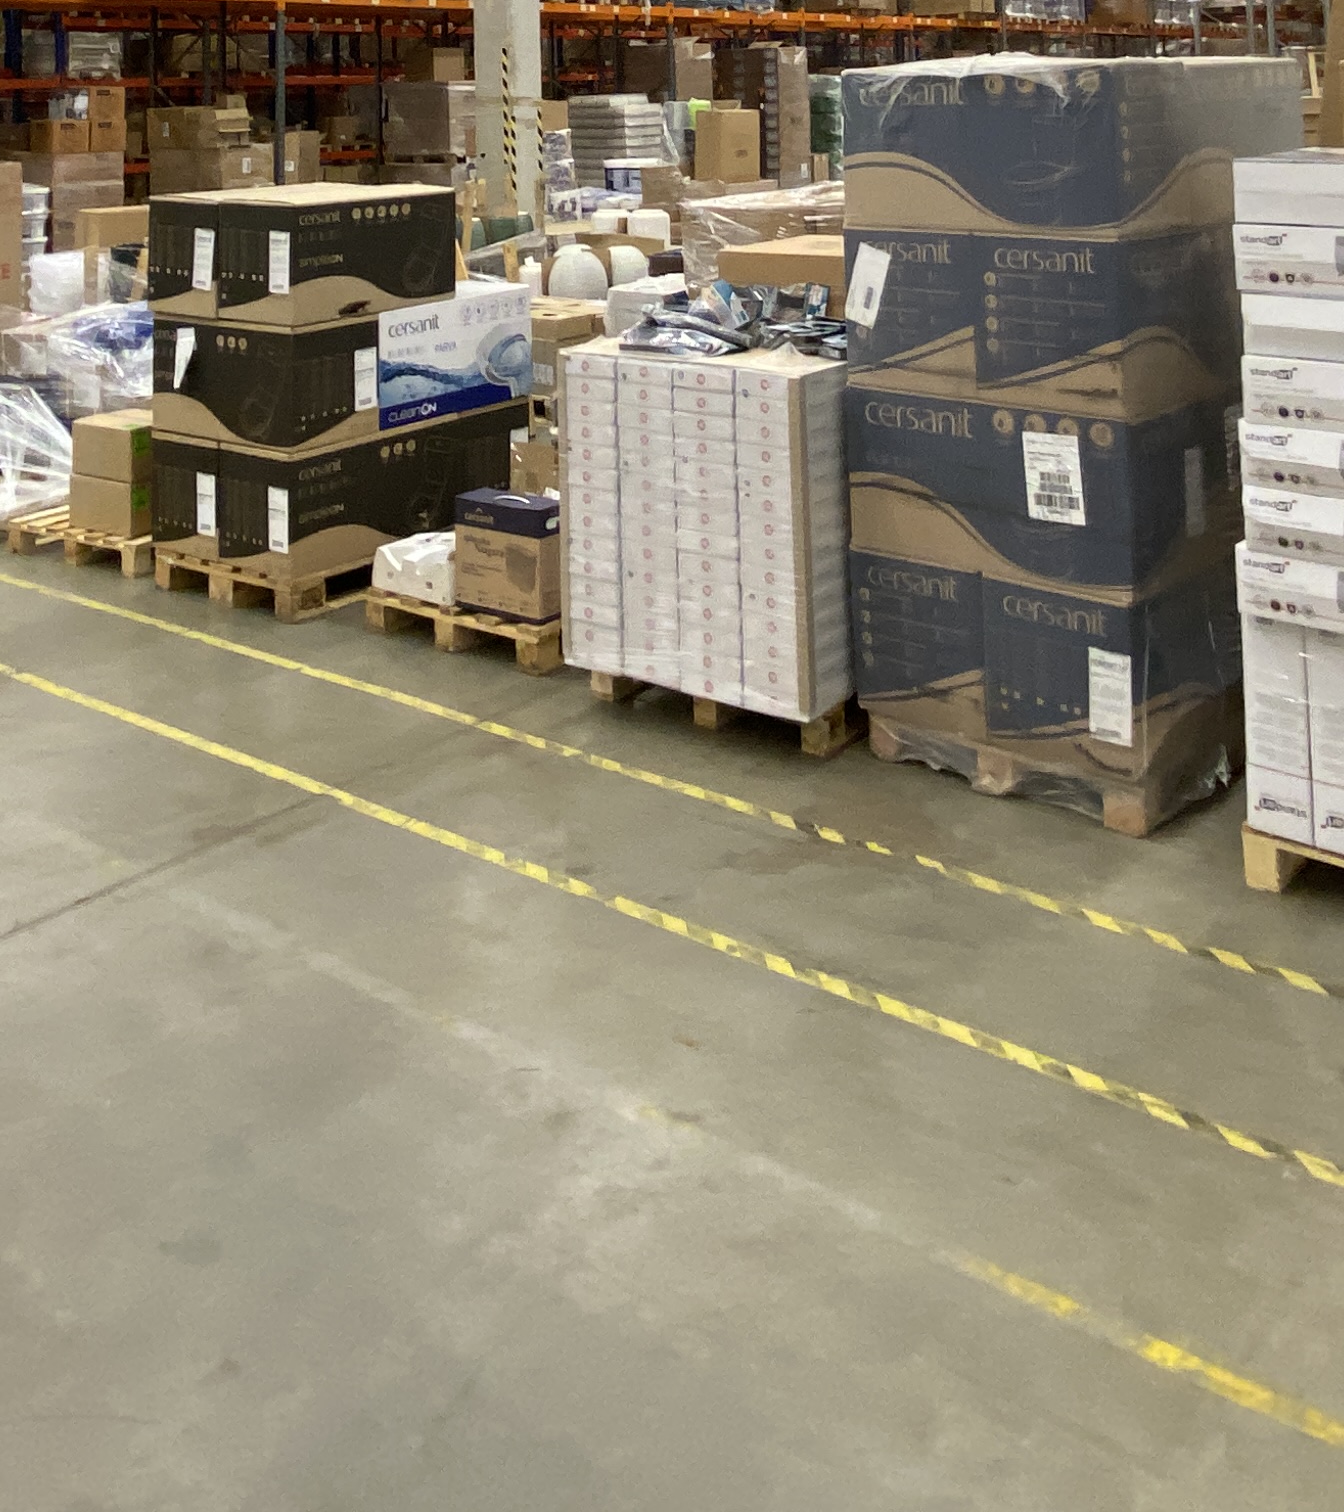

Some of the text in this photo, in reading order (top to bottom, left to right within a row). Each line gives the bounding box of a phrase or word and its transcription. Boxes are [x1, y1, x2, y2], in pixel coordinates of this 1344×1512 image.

[993, 247, 1095, 274] cersanit
[388, 313, 440, 338] cersanit
[864, 401, 973, 439] cersanit
[1002, 595, 1106, 636] cersanit
